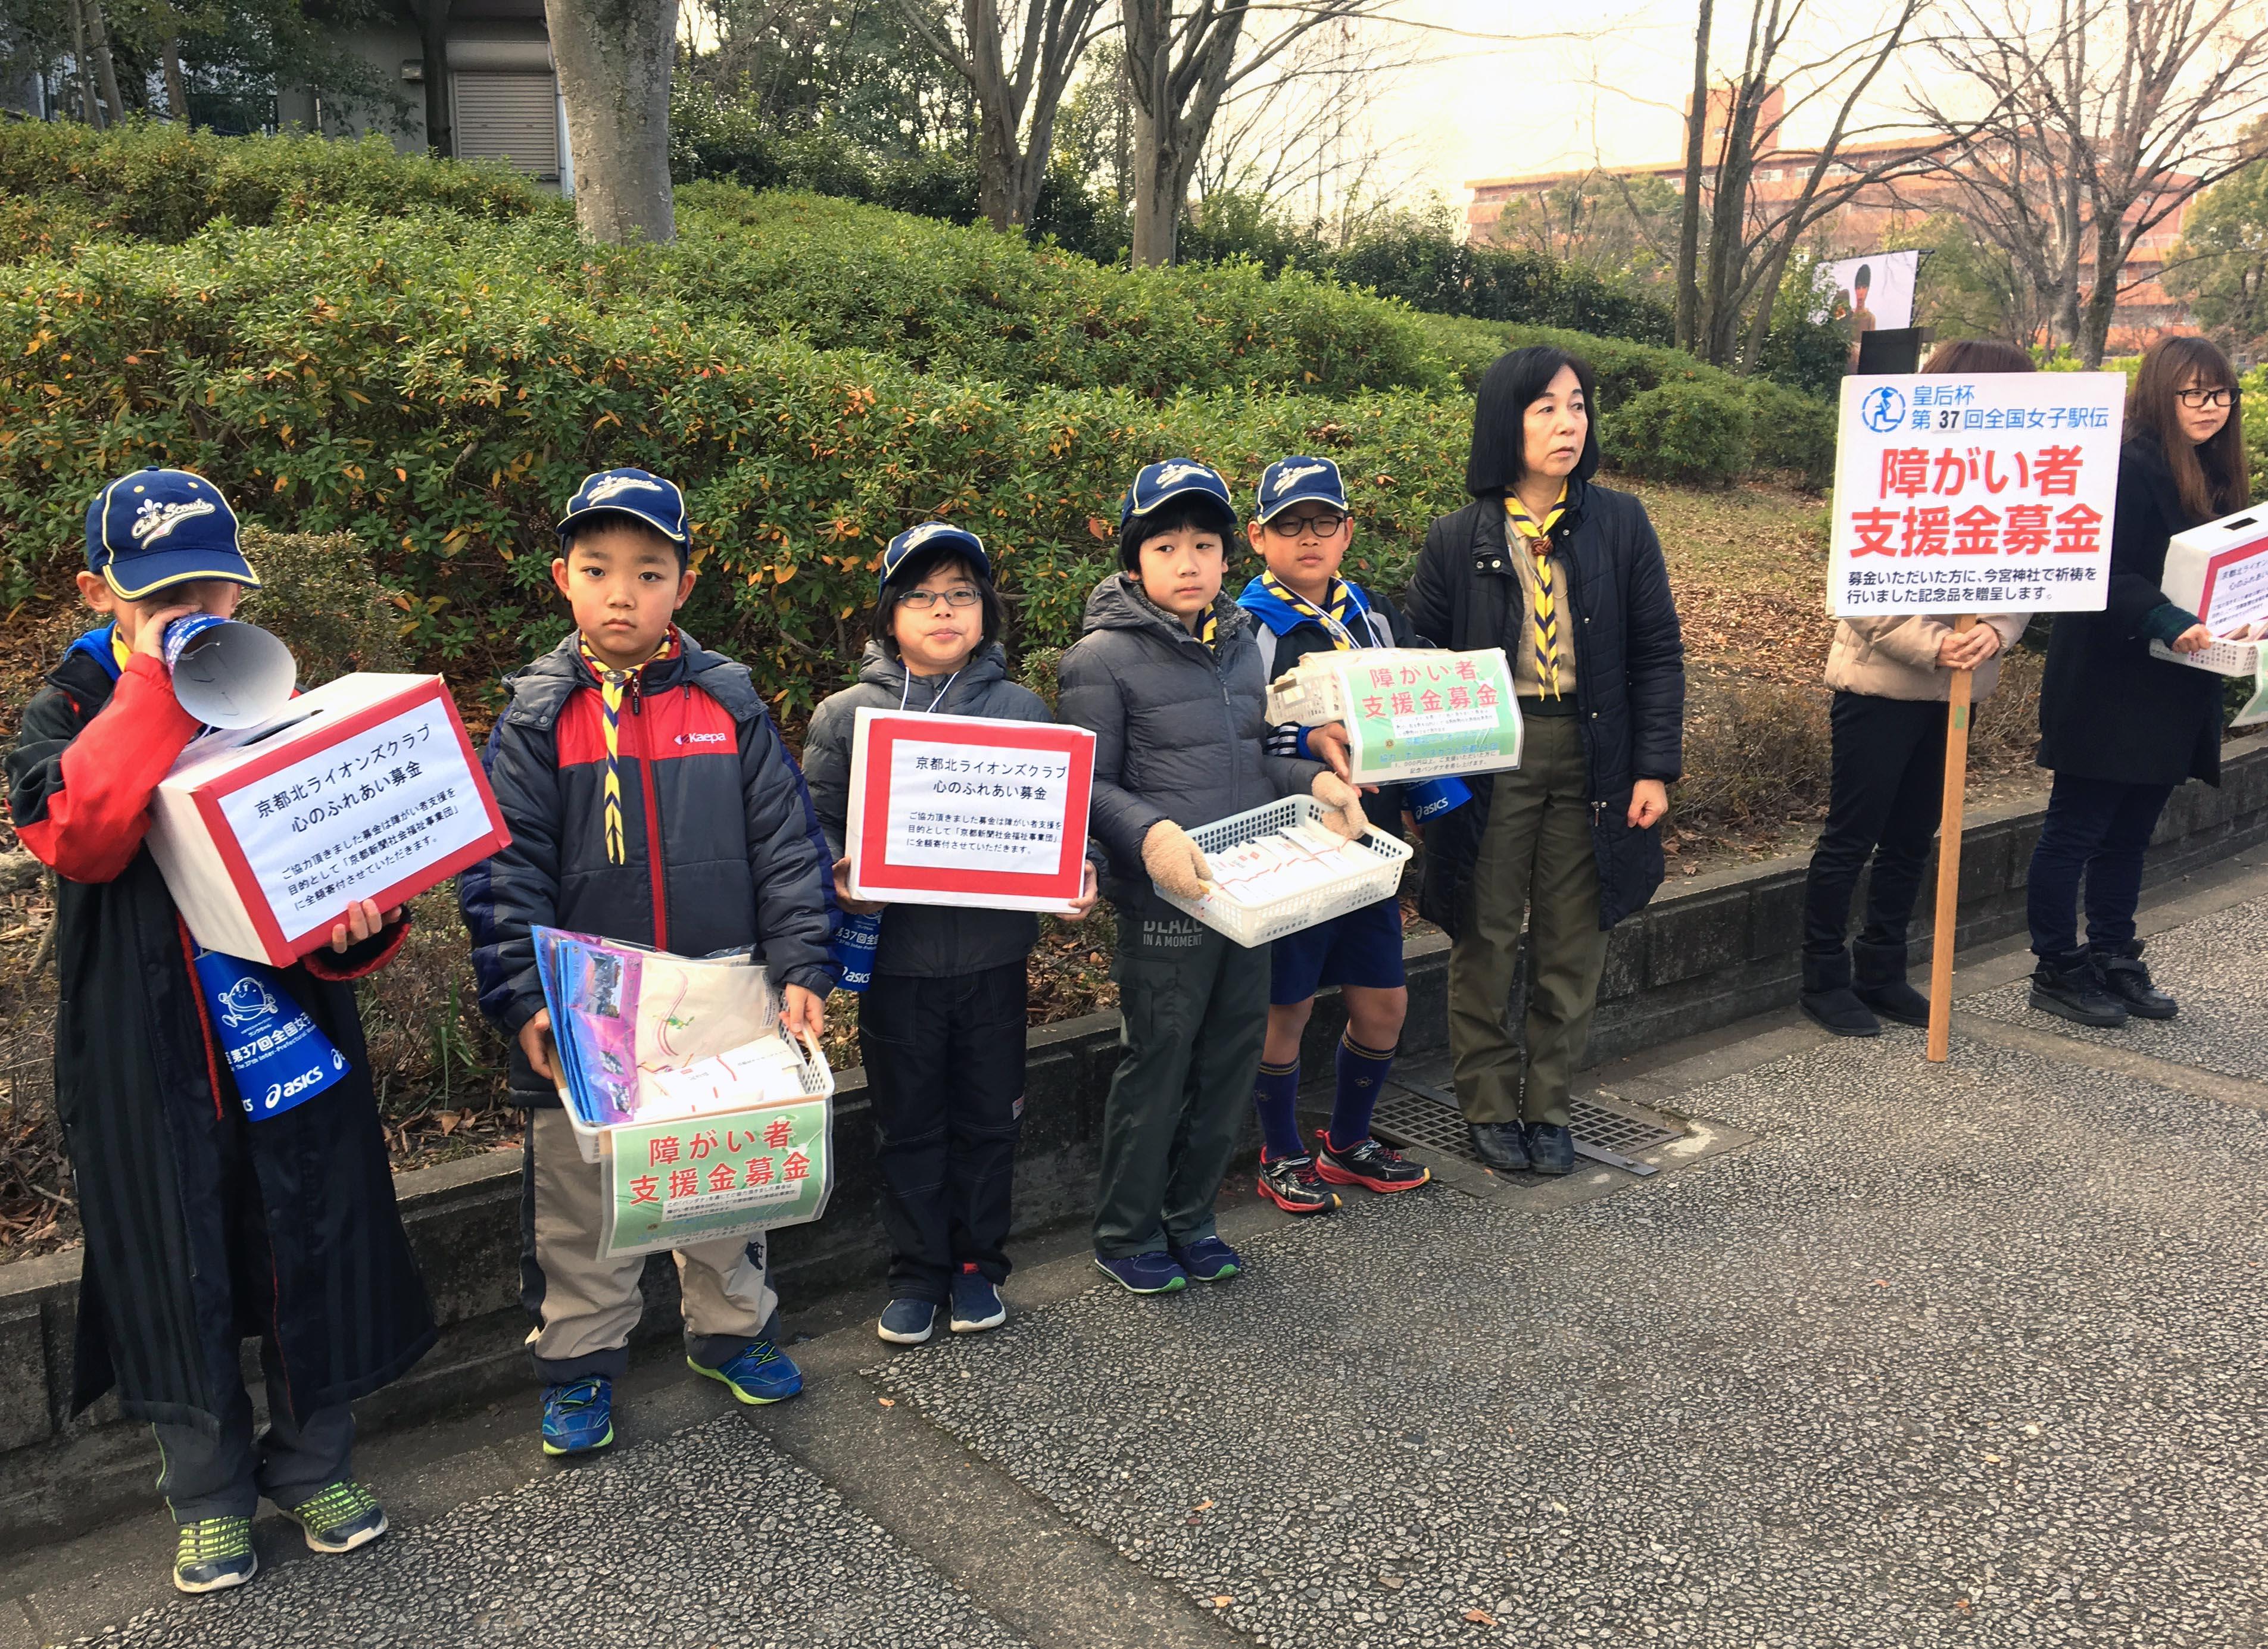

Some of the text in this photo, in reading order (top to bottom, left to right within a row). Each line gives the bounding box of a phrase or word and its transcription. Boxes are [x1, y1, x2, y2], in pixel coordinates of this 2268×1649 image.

[1912, 385, 1976, 407] 皇后杯
[1879, 444, 2084, 499] 障がい者
[161, 498, 212, 520] Scouts
[1849, 503, 2104, 558] 支援金募金
[1847, 586, 2052, 604] 行いました記念品を贈呈します。
[1369, 660, 1477, 689] 障がい者
[1362, 683, 1499, 720] 支援金募金
[689, 733, 726, 744] Kaepa
[254, 723, 430, 819] 京都北ライオンズクラブ
[916, 757, 1067, 778] 京都北ライオンズクラブ
[292, 760, 423, 833] 心のふれあい募金
[934, 780, 1047, 800] 心のふれあい募金
[909, 811, 1062, 830] ご協力頂きました募金は障がい者支援を
[1424, 797, 1448, 815] asics
[282, 788, 456, 880] ご協力頂きました募金は障がい者支援を
[1143, 934, 1202, 947] IN A MOMENT
[283, 1066, 323, 1097] asics
[649, 1120, 793, 1167] 障がい者
[629, 1152, 811, 1205] 支援金募金
